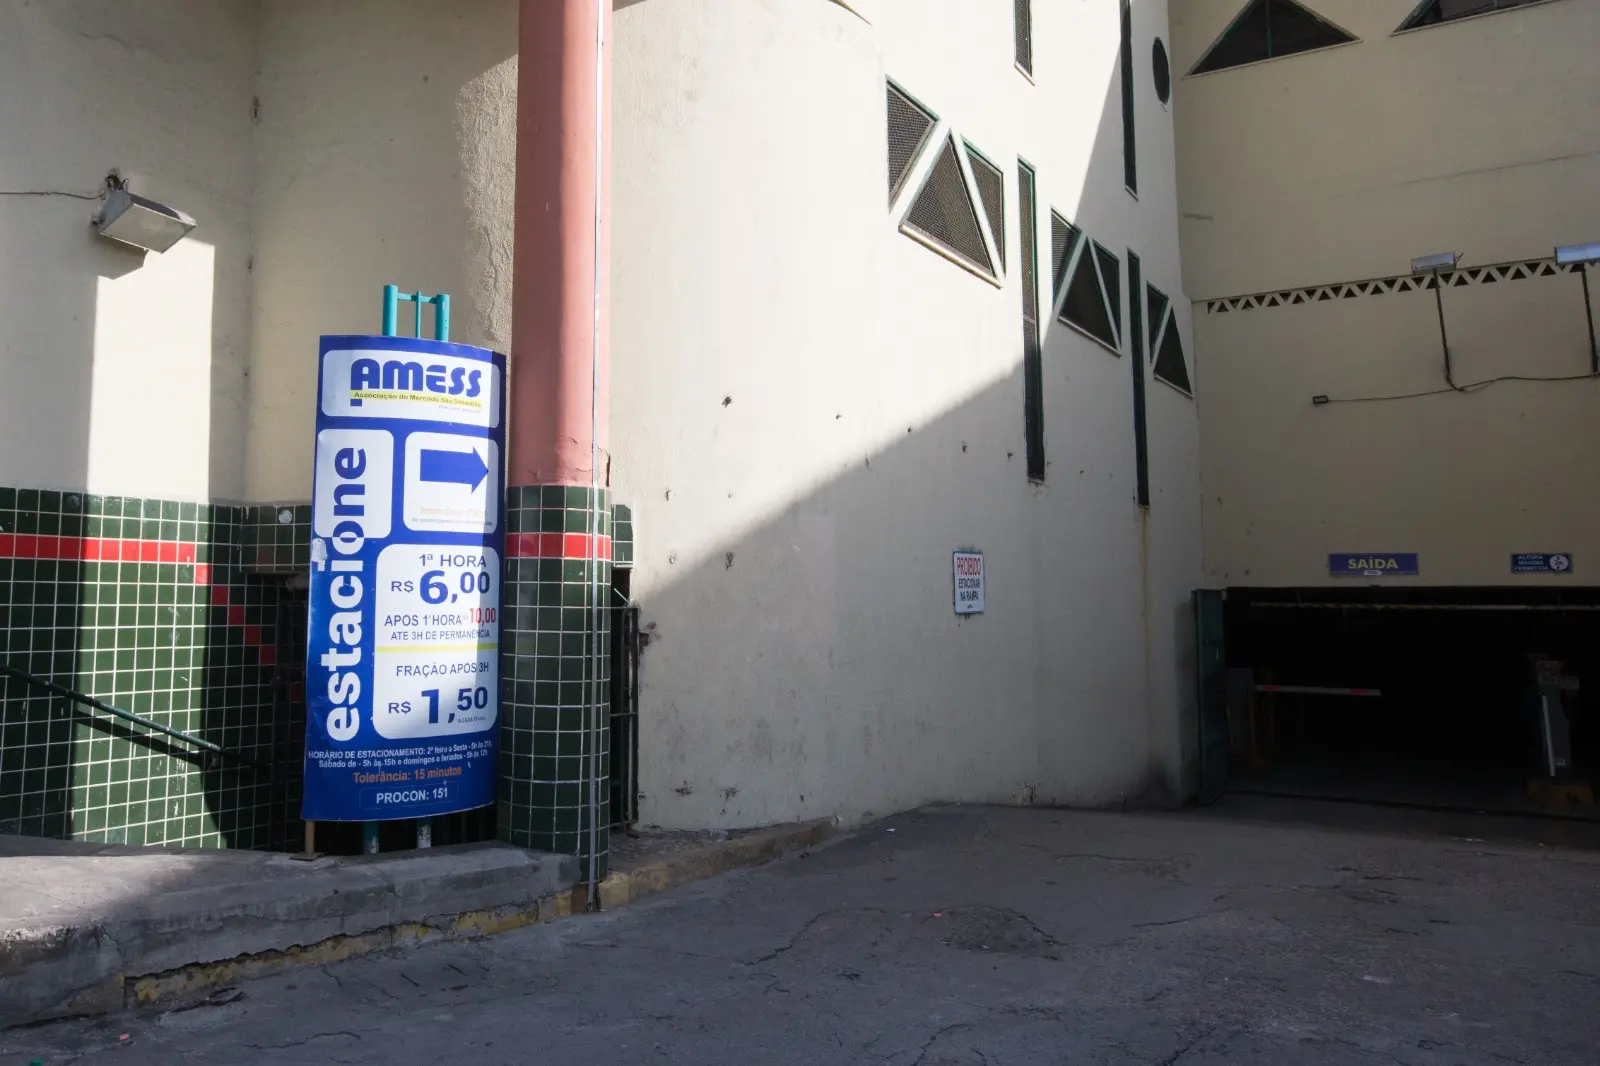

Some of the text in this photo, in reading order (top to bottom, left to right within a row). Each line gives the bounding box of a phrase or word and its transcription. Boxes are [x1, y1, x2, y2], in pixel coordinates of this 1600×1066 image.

[350, 358, 482, 398] AMESS
[440, 554, 487, 568] HORA
[957, 557, 981, 576] PROIBIDO
[1348, 556, 1398, 569] SAÍDA
[326, 447, 366, 742] estacione
[391, 569, 490, 605] R$ 6,00
[960, 591, 966, 601] NA
[432, 614, 462, 626] HORA
[469, 607, 496, 627] 10,00
[411, 631, 423, 640] 3H
[425, 630, 437, 640] DE
[396, 662, 447, 678] FRAÇÃO
[478, 661, 489, 673] 3H
[388, 686, 488, 724] R$ 1,50
[308, 750, 344, 759] HORÁRIO
[345, 750, 356, 759] DE
[357, 747, 426, 759] ESTACIONAMENTO:
[434, 746, 447, 754] feira
[453, 744, 468, 752] Sexta
[319, 759, 346, 768] Sábado
[362, 759, 372, 767] 5h
[384, 758, 396, 767] 15h
[403, 757, 435, 765] domingos
[441, 753, 463, 762] feriados
[353, 766, 462, 784] Tolerância: 15 minutos
[376, 787, 448, 804] PROCON: 151
